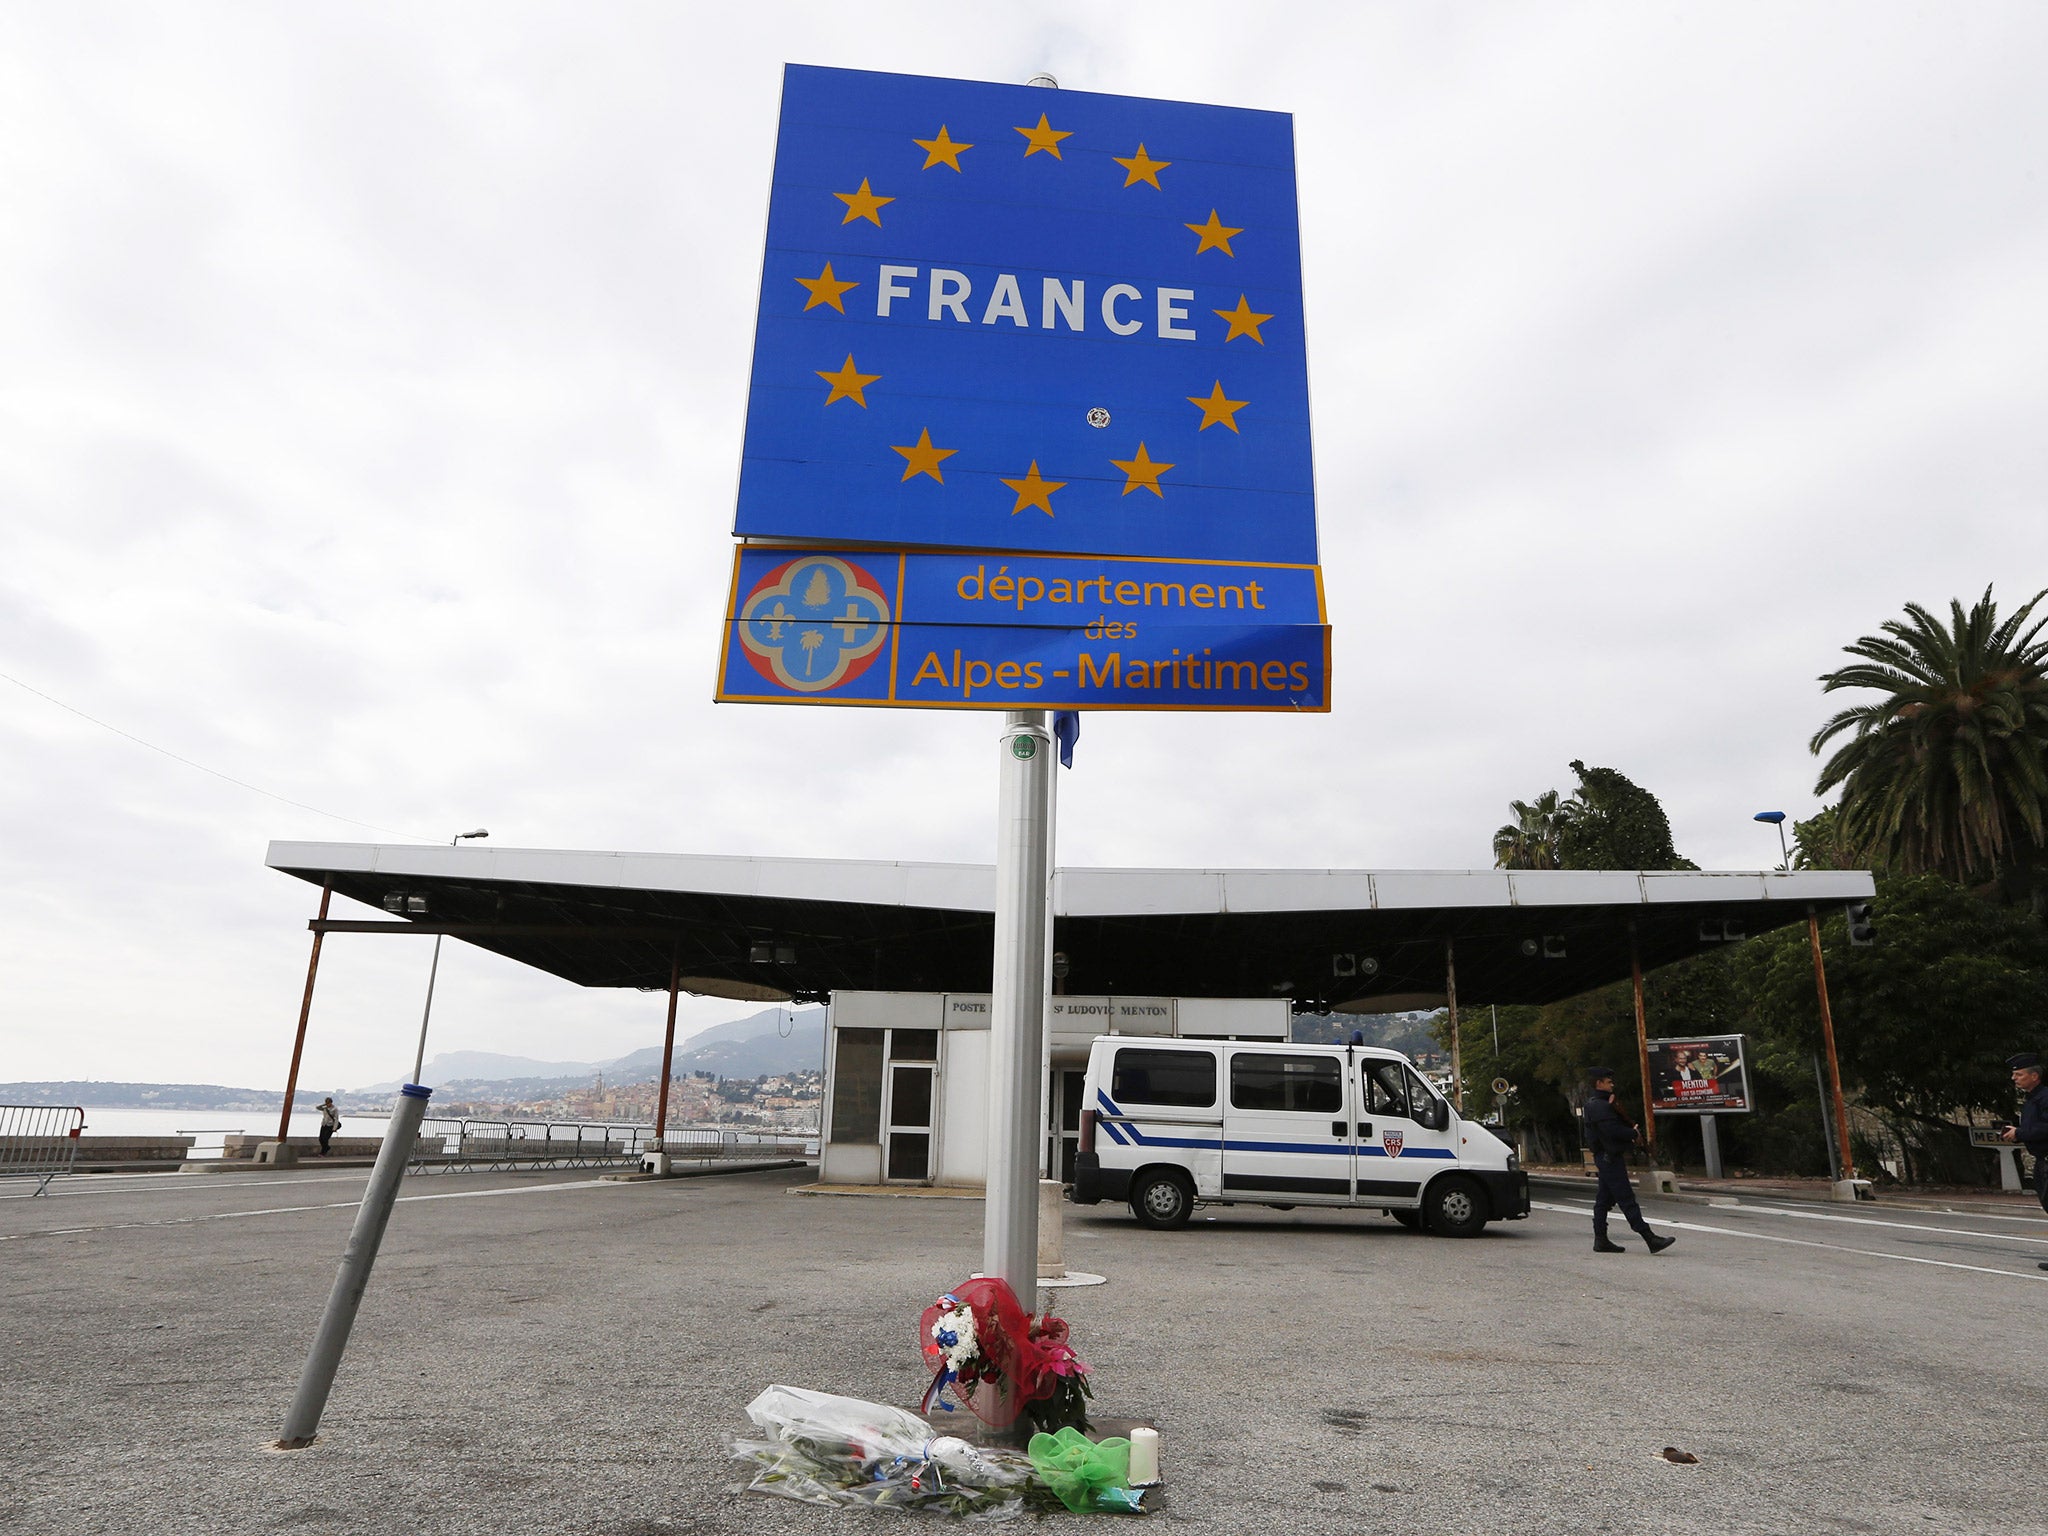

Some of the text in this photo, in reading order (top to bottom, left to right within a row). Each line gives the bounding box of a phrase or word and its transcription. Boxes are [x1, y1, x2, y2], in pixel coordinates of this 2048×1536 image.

[877, 264, 1196, 341] FRANCE
[957, 565, 1265, 611] département
[1085, 615, 1137, 640] des
[952, 1002, 986, 1013] POSTE
[1068, 1005, 1115, 1015] LUDOVIC
[1121, 1006, 1168, 1016] MENTON
[1681, 1079, 1709, 1089] MENTON
[1385, 1138, 1402, 1146] CRS
